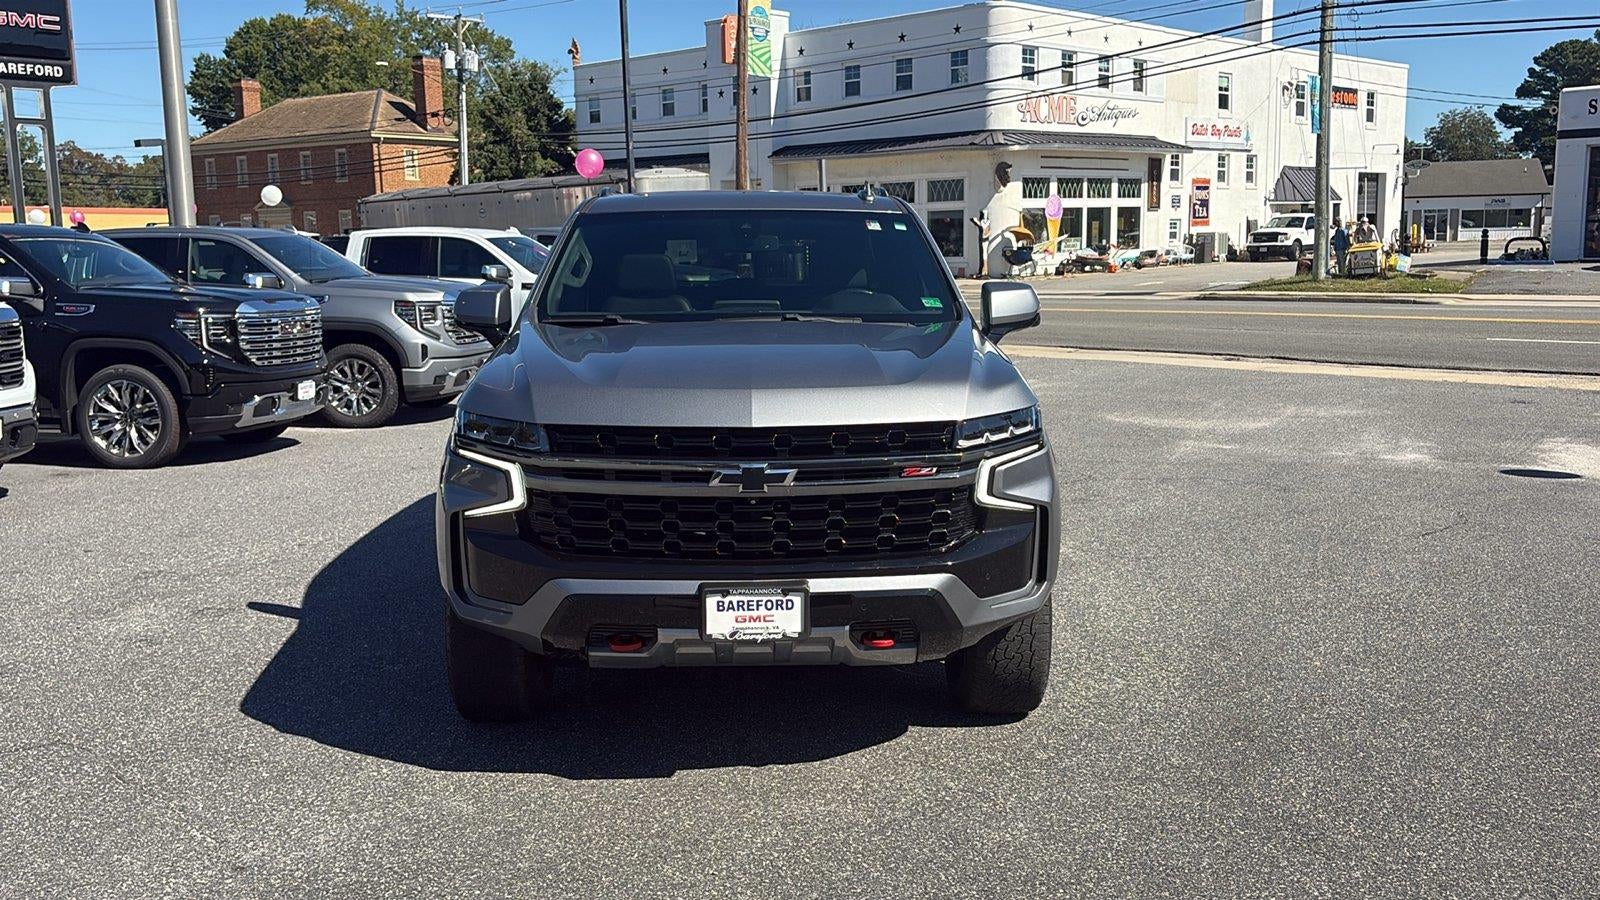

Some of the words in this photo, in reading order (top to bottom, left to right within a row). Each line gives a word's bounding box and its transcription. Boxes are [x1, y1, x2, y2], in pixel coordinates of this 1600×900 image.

[1017, 95, 1078, 125] ACME
[1191, 123, 1208, 136] Dutch
[1211, 124, 1222, 140] Boy
[1223, 125, 1242, 138] Paints
[1194, 204, 1208, 218] TEA
[716, 599, 795, 612] BAREFORD
[735, 614, 775, 624] GMC
[728, 629, 785, 643] Bareford
